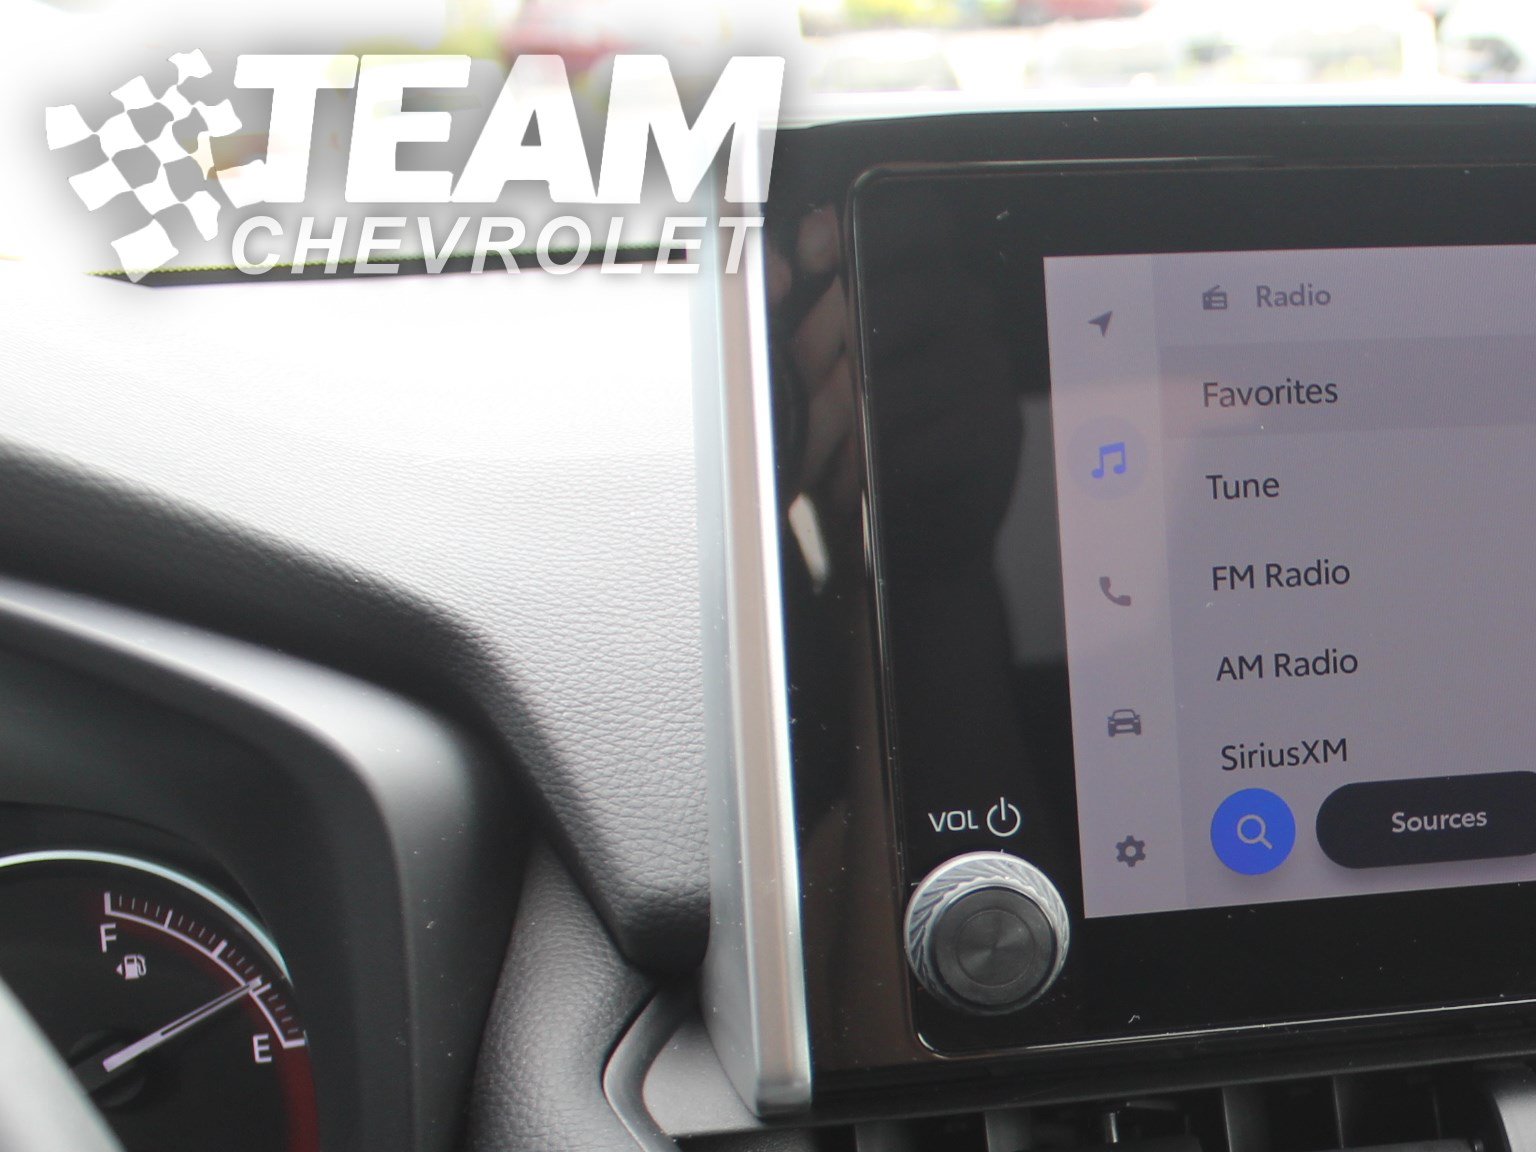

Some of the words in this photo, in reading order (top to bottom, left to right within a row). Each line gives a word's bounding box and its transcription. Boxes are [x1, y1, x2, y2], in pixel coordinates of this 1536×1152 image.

[1256, 284, 1332, 308] Radio
[1202, 378, 1339, 407] Favorites
[1206, 473, 1280, 500] Tune
[1212, 564, 1255, 591] FM
[1265, 559, 1351, 588] Radio
[1216, 654, 1263, 681] AM
[1274, 649, 1359, 677] Radio
[1220, 738, 1348, 772] SiriusXM
[928, 810, 978, 832] VOL
[1391, 808, 1488, 833] Sources
[100, 923, 117, 952] F
[253, 1034, 272, 1063] E
